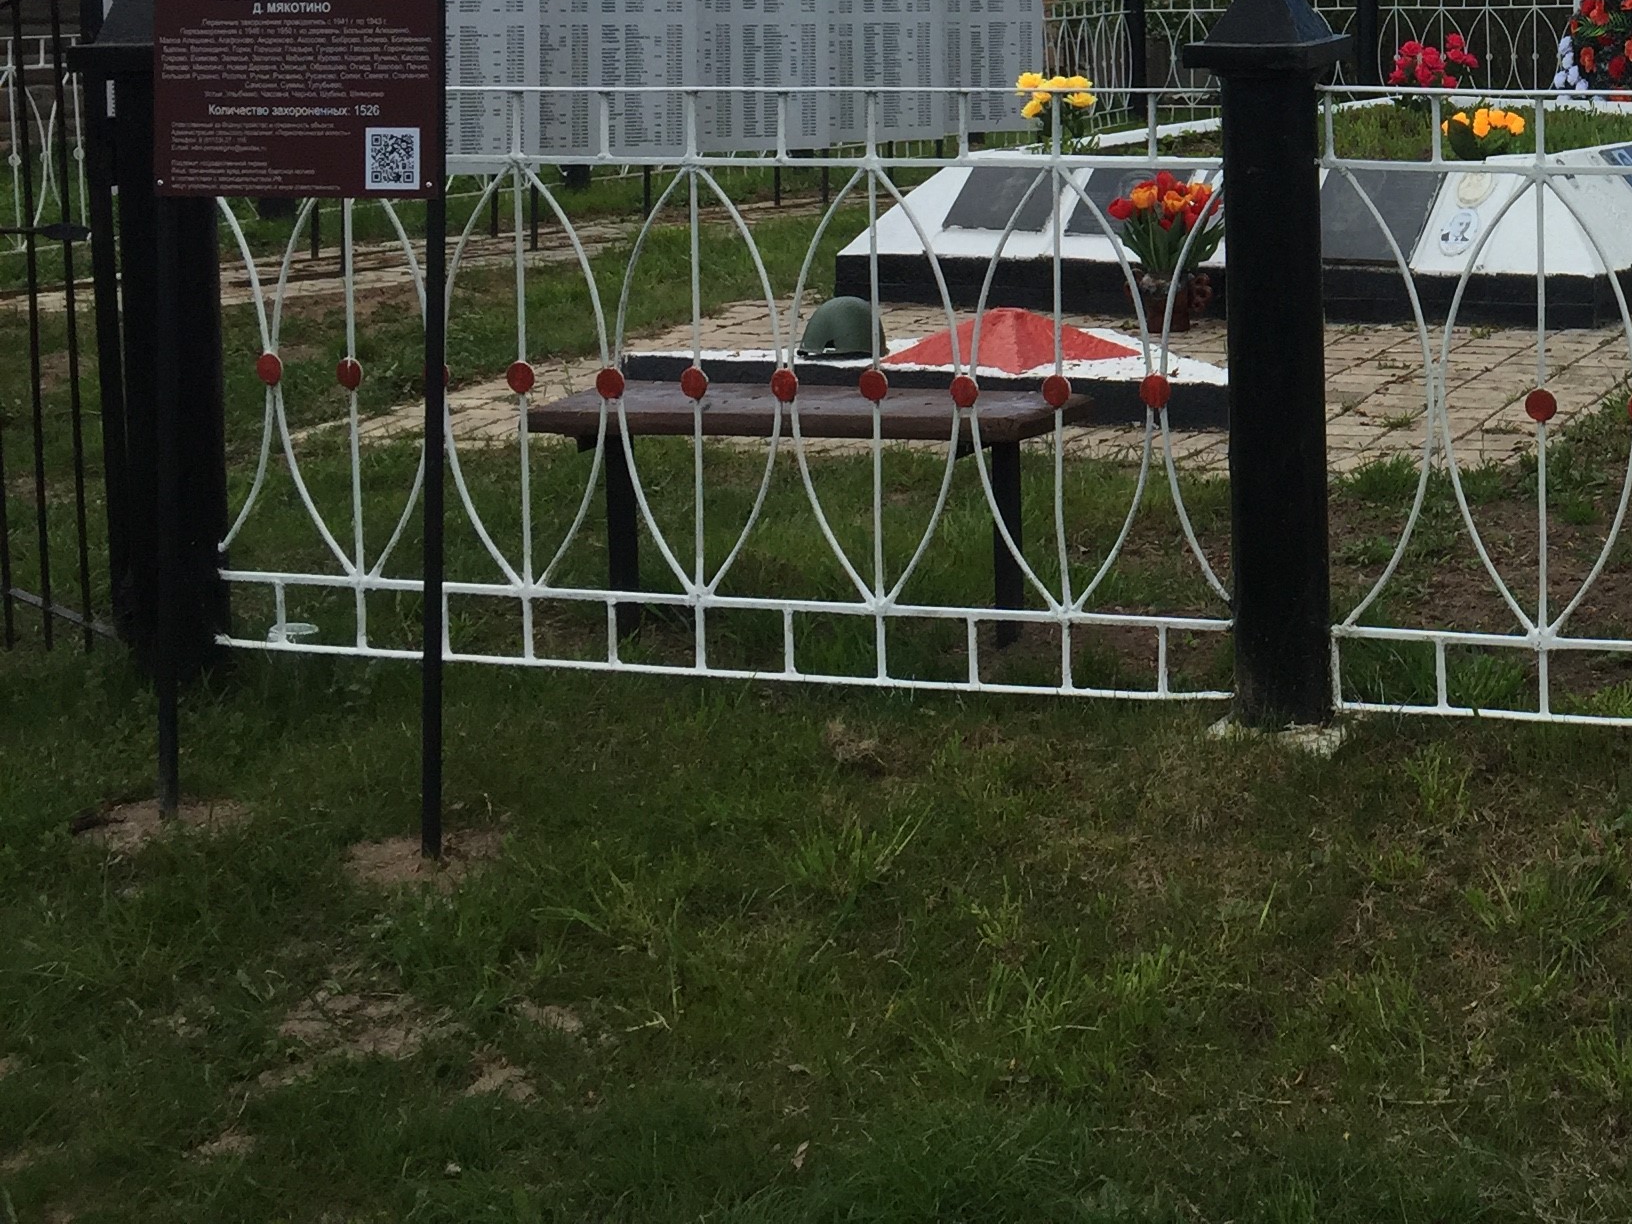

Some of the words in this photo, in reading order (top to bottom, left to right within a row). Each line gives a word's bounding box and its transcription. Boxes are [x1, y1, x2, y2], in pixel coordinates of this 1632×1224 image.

[266, 2, 331, 13] МЯКОТИНО
[208, 104, 269, 116] Количество
[271, 105, 351, 117] захороненных:
[354, 104, 380, 116] 1526
